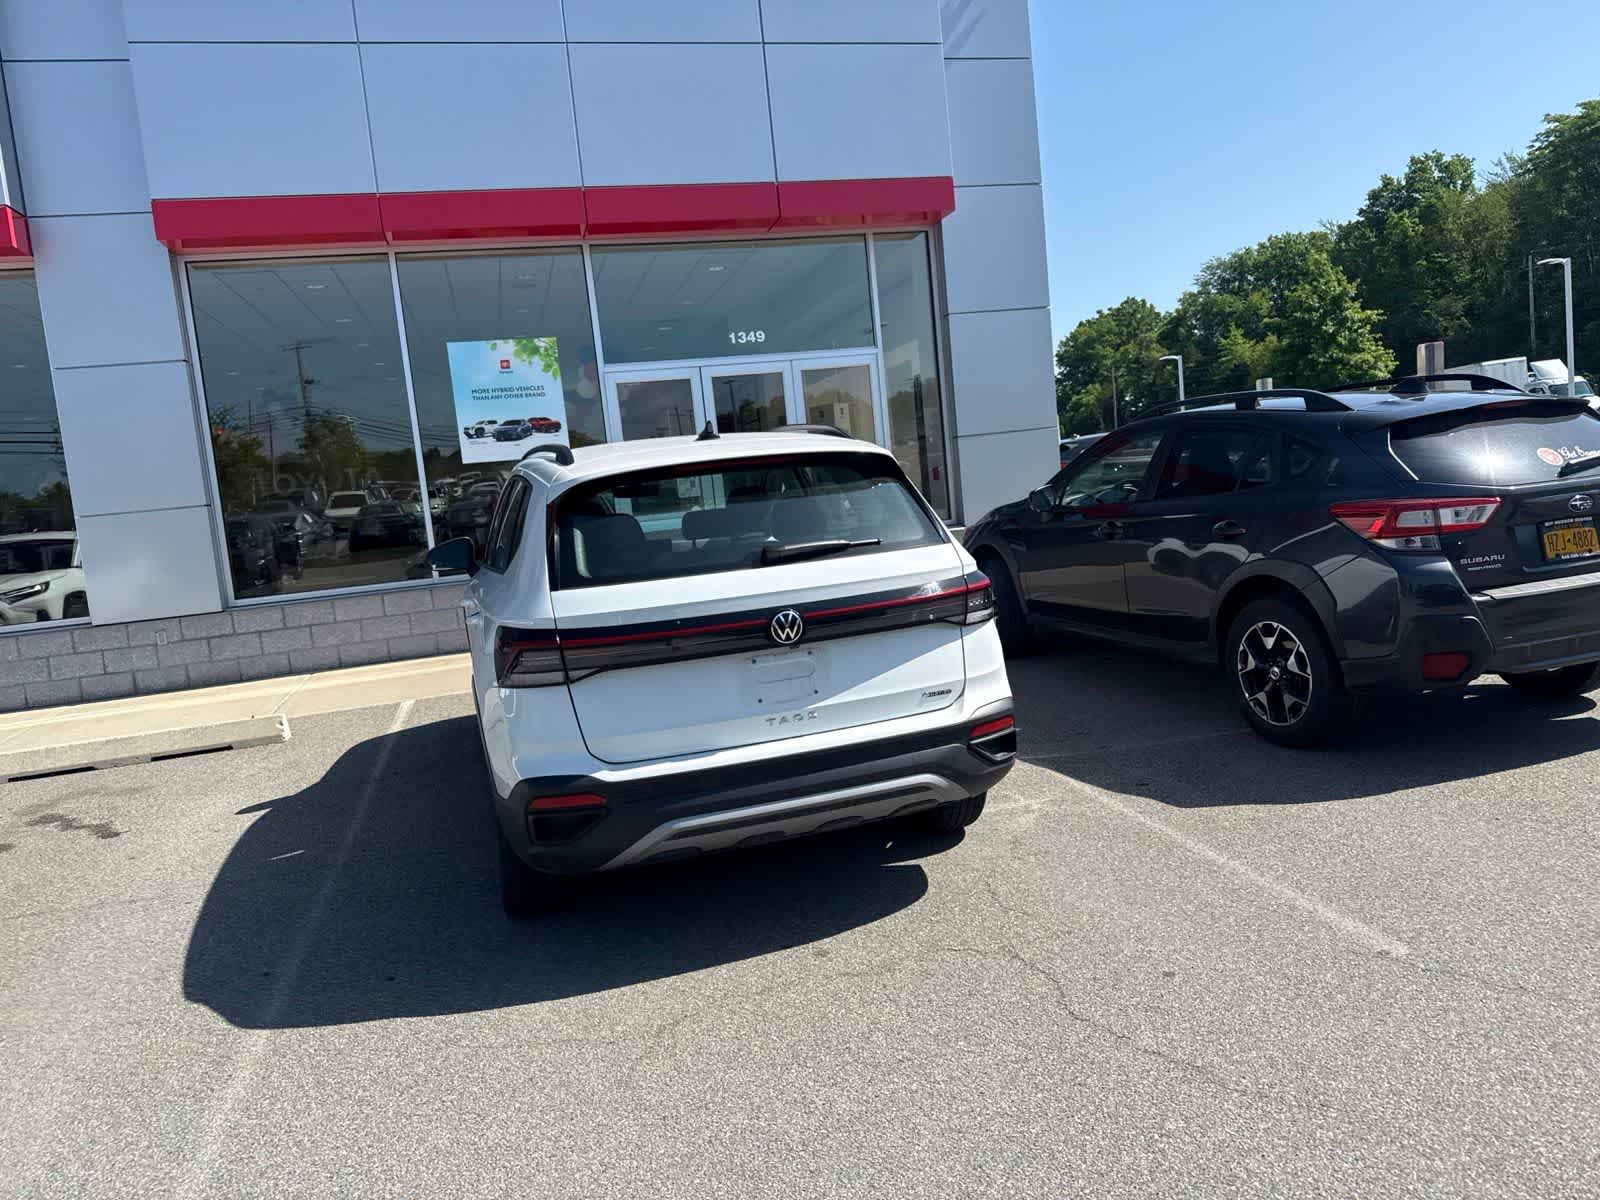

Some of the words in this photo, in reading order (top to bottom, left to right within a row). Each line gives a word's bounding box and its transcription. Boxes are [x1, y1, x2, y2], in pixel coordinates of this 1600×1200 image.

[728, 330, 766, 344] 1349
[471, 387, 490, 395] MORE
[1459, 553, 1505, 565] SUBARU
